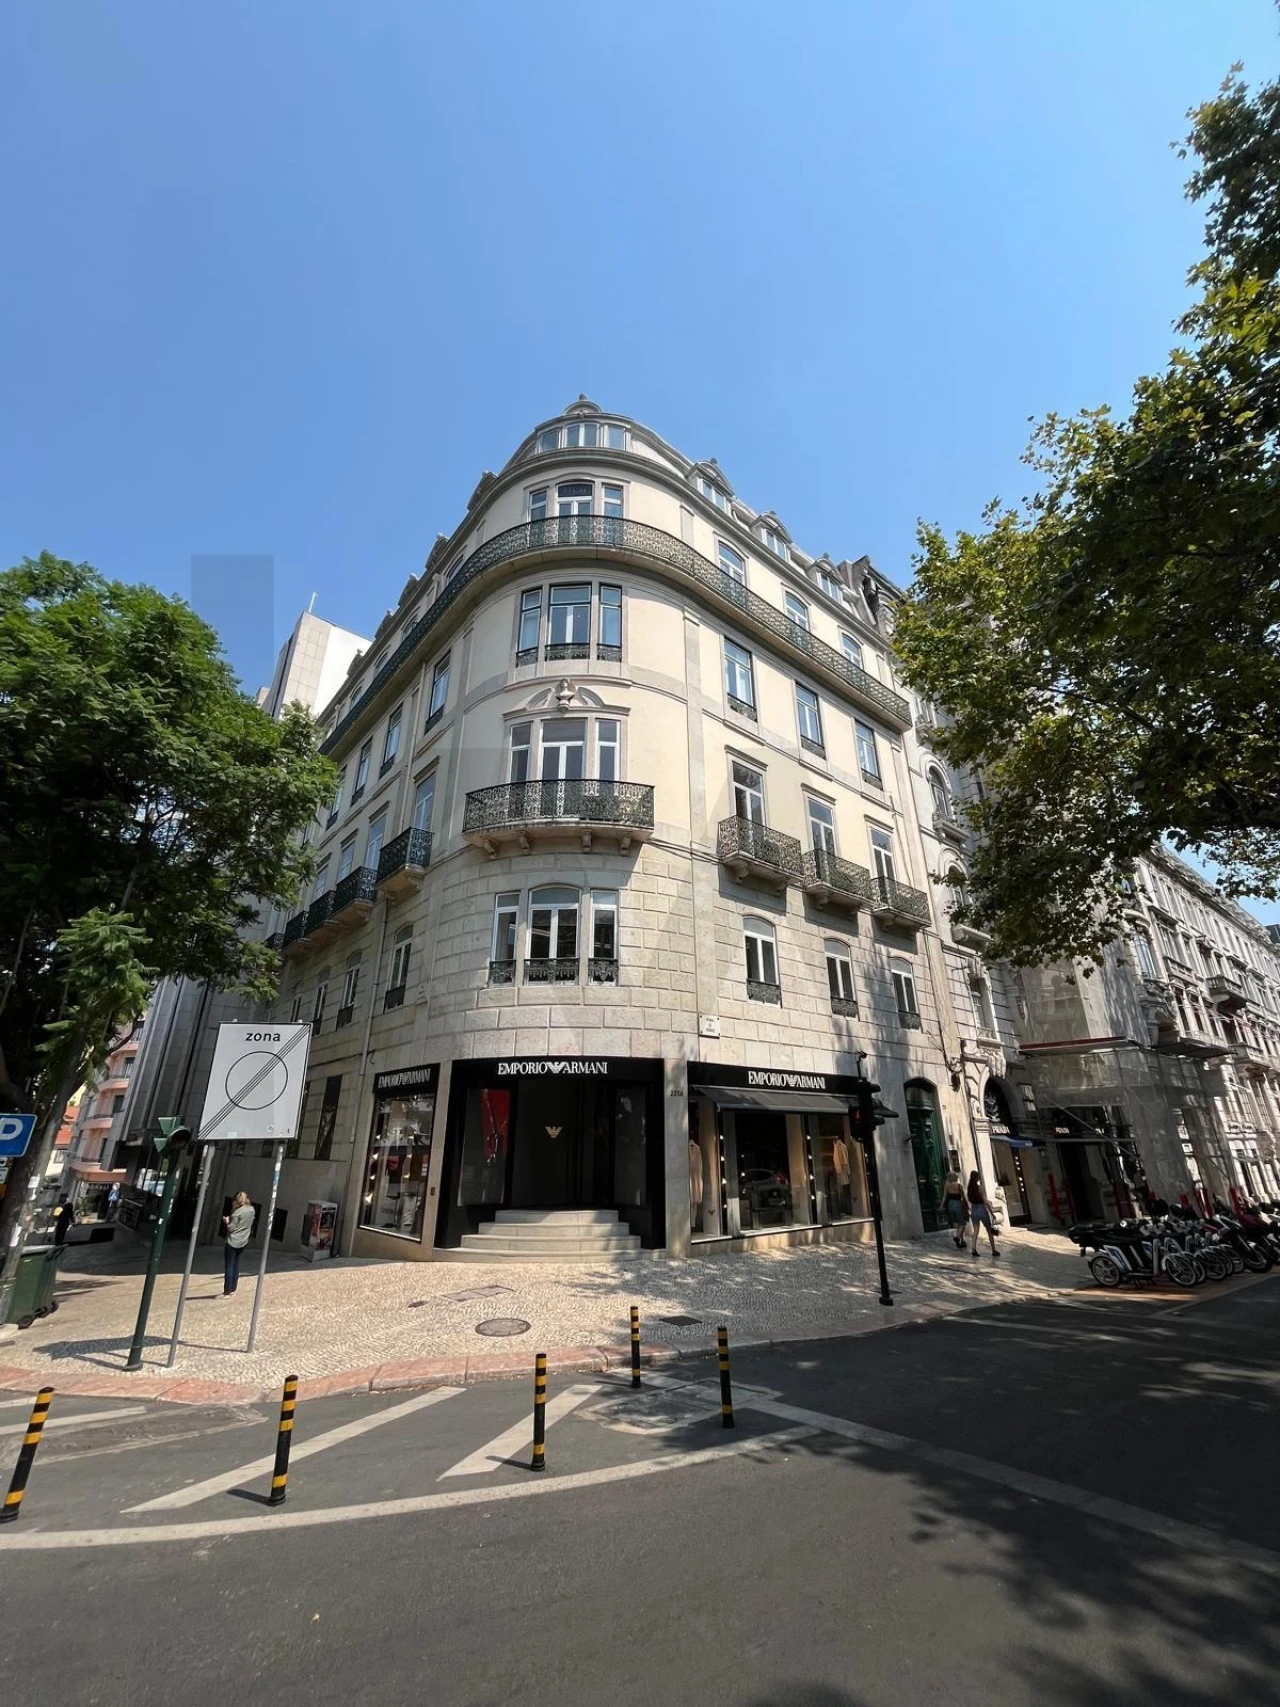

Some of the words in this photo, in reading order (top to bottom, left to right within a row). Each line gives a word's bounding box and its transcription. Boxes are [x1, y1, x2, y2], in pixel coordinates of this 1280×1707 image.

[245, 1032, 281, 1042] zona
[497, 1061, 549, 1075] EMPORIO
[561, 1061, 608, 1075] ARMANI
[748, 1070, 787, 1087] EMPORIO
[796, 1074, 826, 1090] ARMANI
